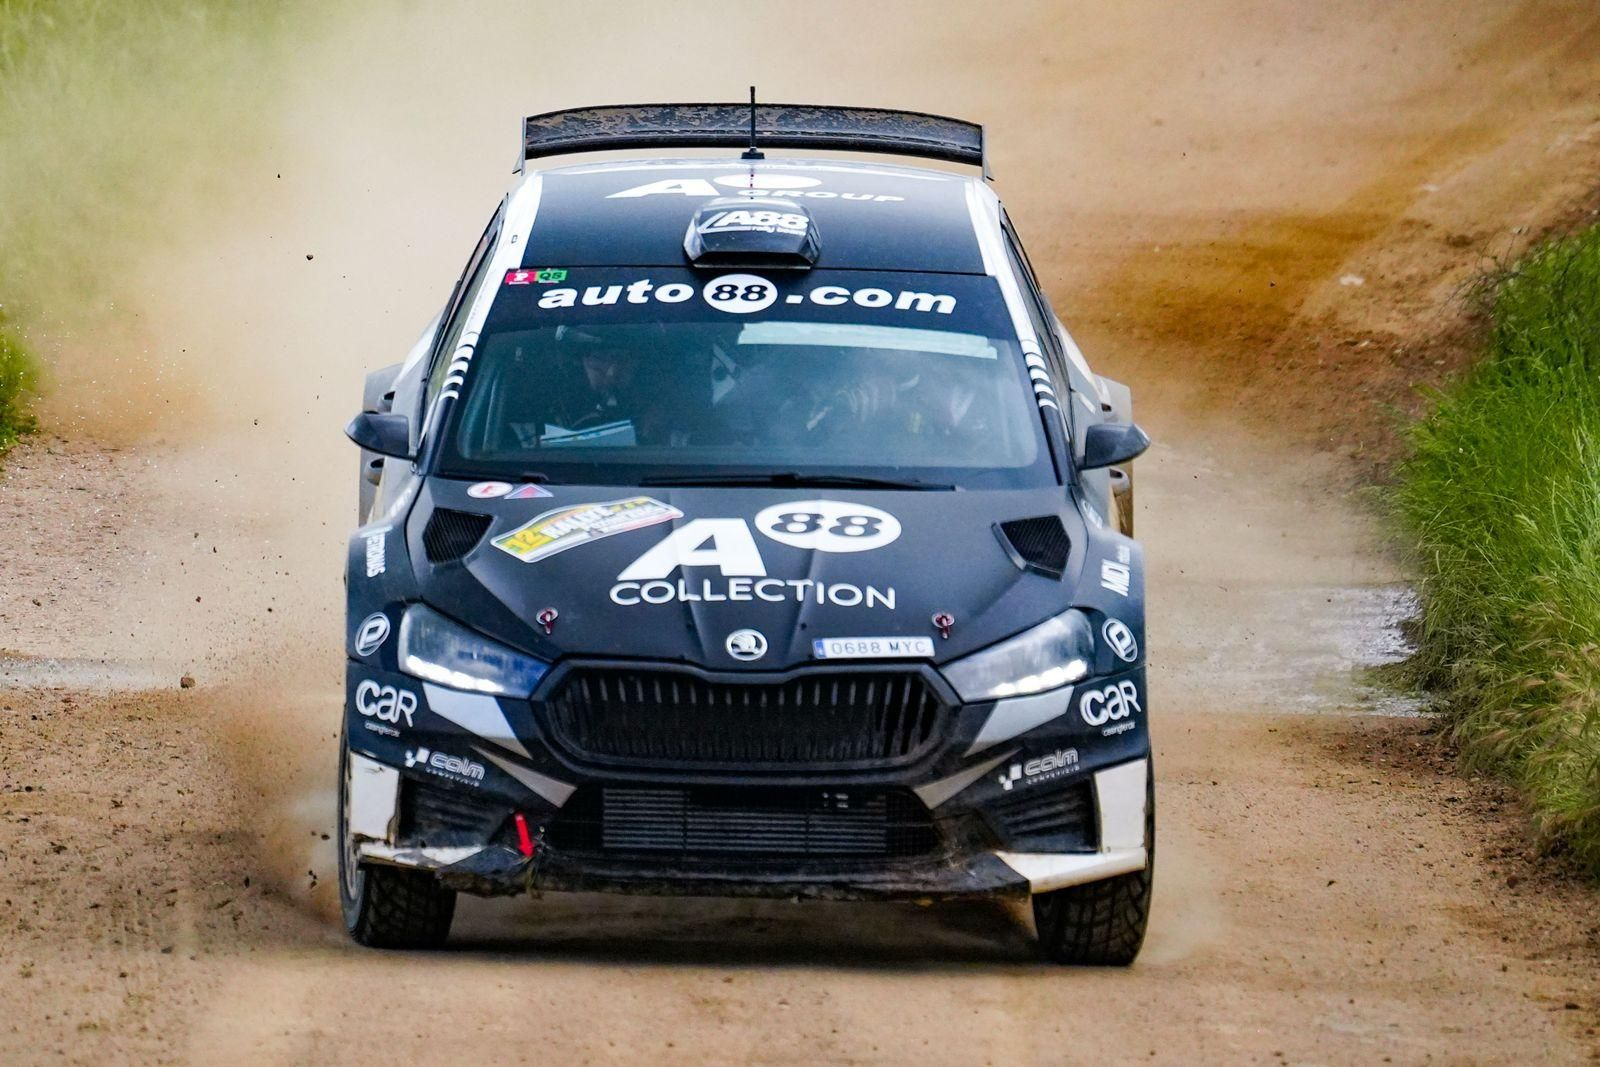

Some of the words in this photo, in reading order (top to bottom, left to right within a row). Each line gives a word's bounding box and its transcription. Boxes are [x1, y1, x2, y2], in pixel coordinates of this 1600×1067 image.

[737, 190, 905, 201] GROUP
[609, 578, 896, 610] COLLECTION
[831, 641, 882, 655] 0688
[430, 751, 486, 780] calm
[1024, 747, 1079, 776] calm
